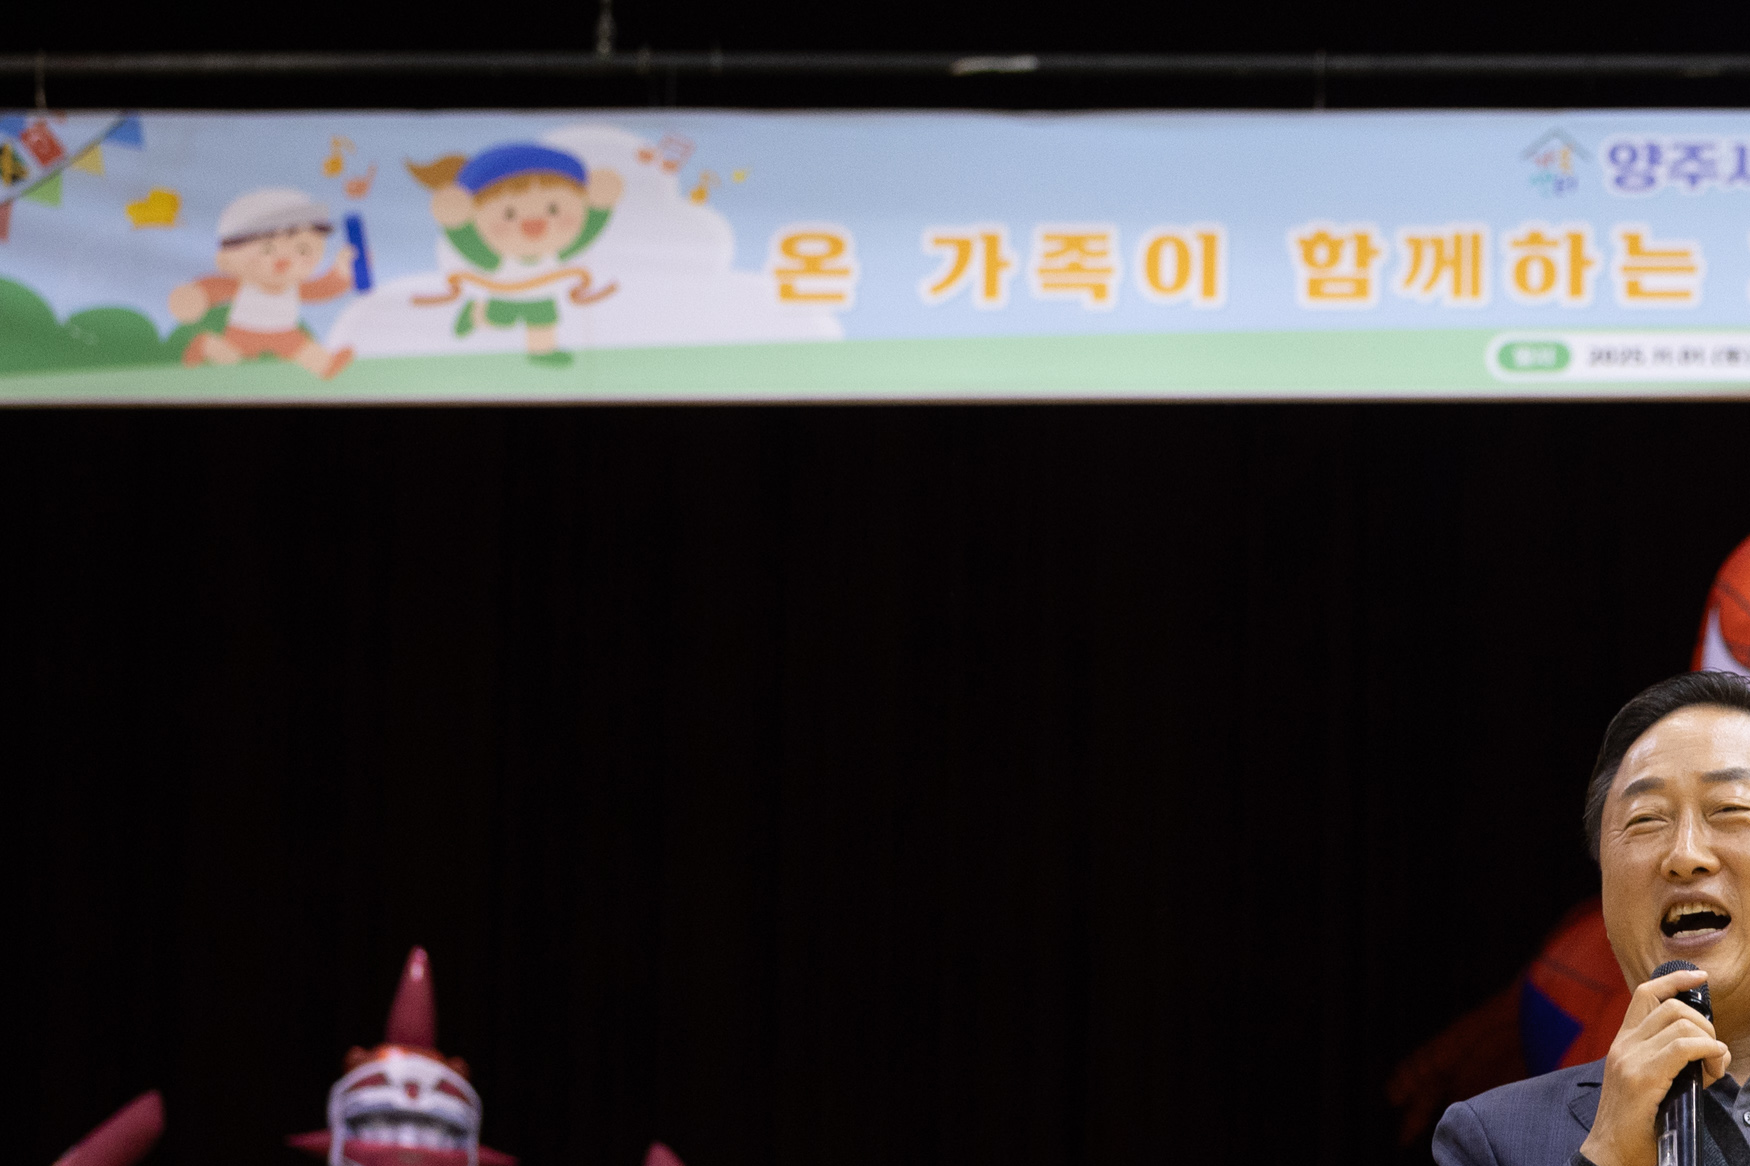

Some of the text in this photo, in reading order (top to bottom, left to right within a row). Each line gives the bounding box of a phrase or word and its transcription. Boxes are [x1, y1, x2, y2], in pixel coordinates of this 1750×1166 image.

[771, 230, 853, 305] 온
[928, 230, 1221, 304] 가족이
[1295, 229, 1698, 303] 함께하는
